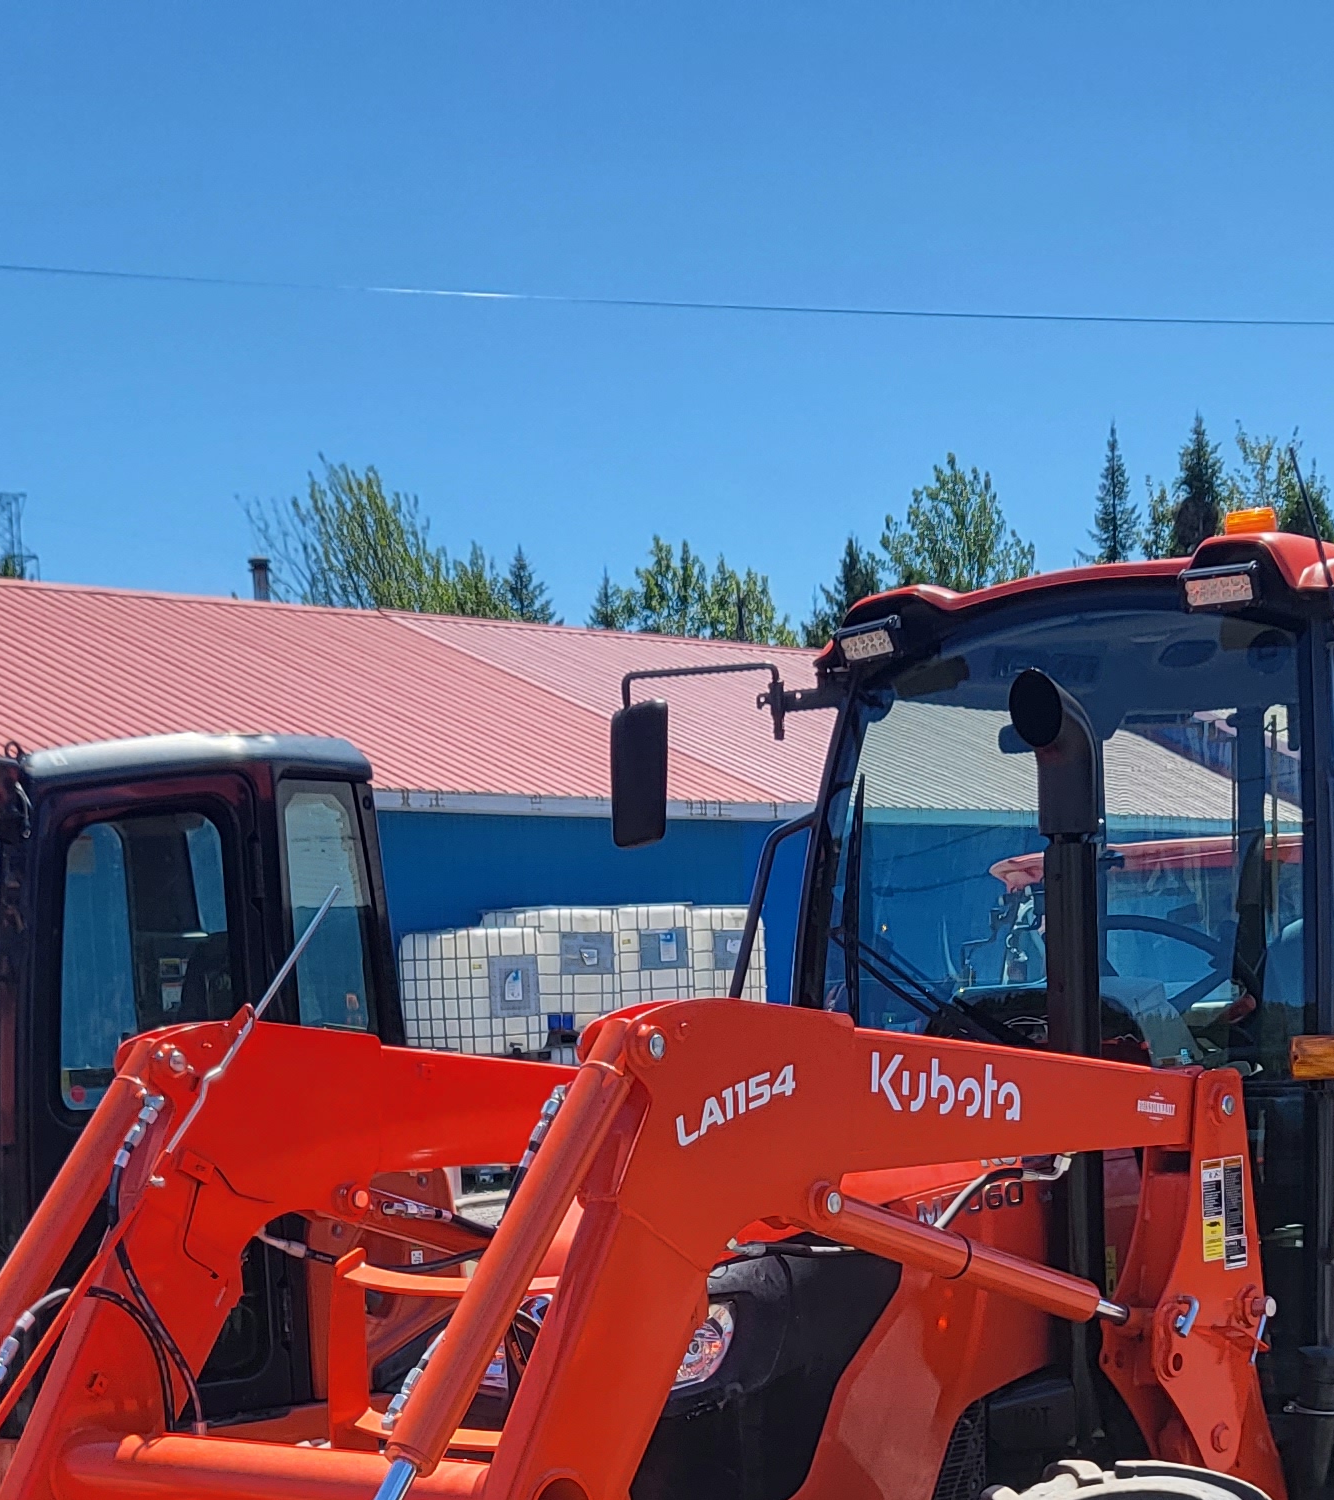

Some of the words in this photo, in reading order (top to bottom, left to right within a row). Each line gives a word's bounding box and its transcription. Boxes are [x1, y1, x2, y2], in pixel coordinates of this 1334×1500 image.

[675, 1064, 796, 1147] LA1154
[870, 1051, 1021, 1121] Kubota
[915, 1180, 1024, 1226] M060
